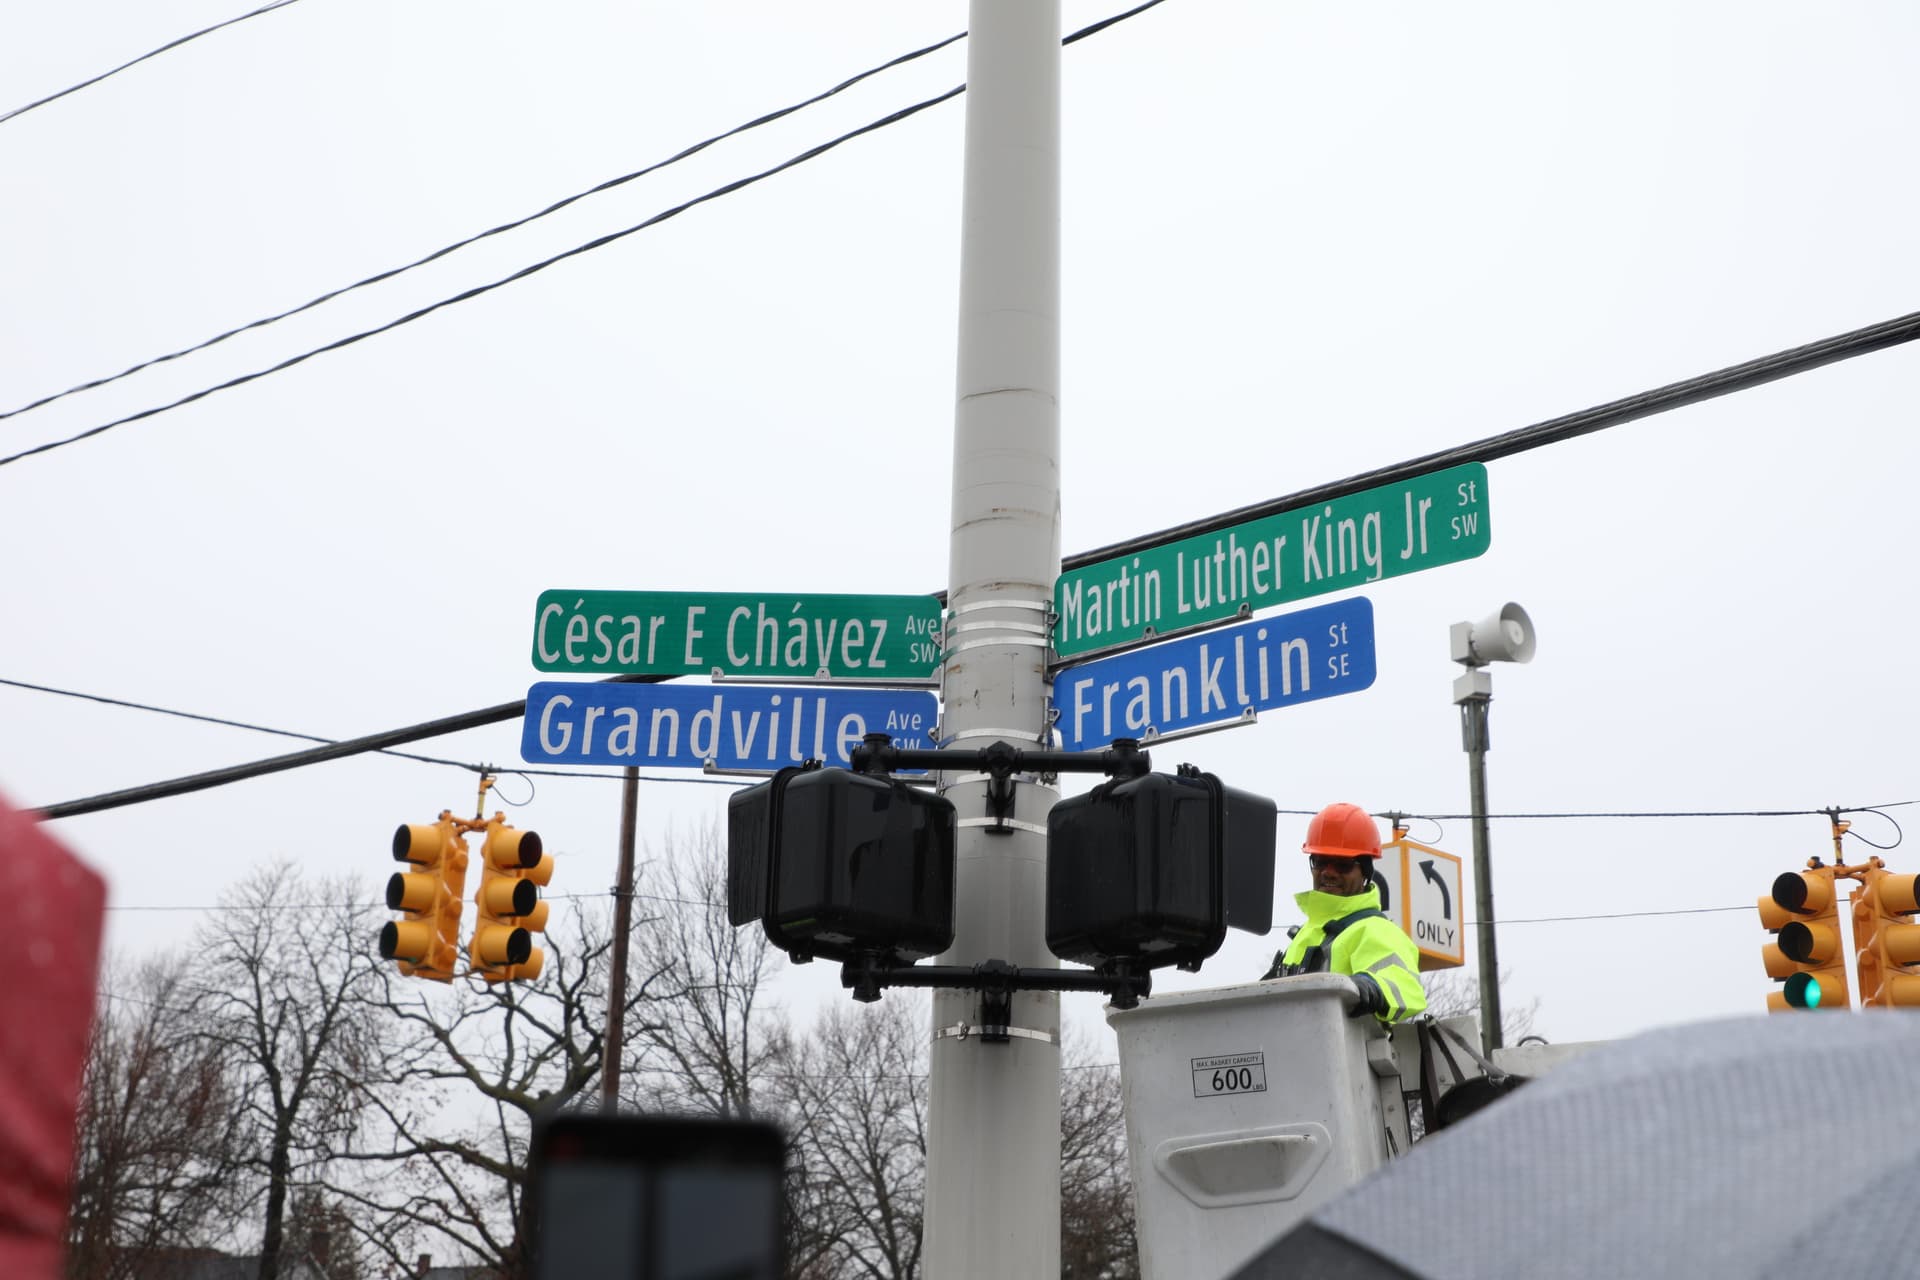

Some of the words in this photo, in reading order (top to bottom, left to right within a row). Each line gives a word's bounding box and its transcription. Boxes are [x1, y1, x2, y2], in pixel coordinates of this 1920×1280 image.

[1458, 480, 1477, 506] St
[1451, 511, 1478, 540] SW
[1062, 557, 1161, 643] Martin
[1177, 533, 1286, 614] Luther
[1303, 505, 1382, 582] King
[1400, 491, 1432, 561] Jr
[537, 598, 665, 665] César
[685, 606, 706, 665] E
[726, 602, 888, 668] Chávez
[905, 615, 937, 635] Ave
[1328, 621, 1349, 648] St
[910, 643, 936, 663] SW
[1328, 653, 1350, 679] SE
[1073, 627, 1311, 743] Franklin
[539, 694, 867, 763] Grandville
[886, 710, 922, 731] Ave
[1416, 919, 1455, 948] ONLY
[1232, 1055, 1259, 1065] CAPACITY
[1212, 1067, 1252, 1091] 600
